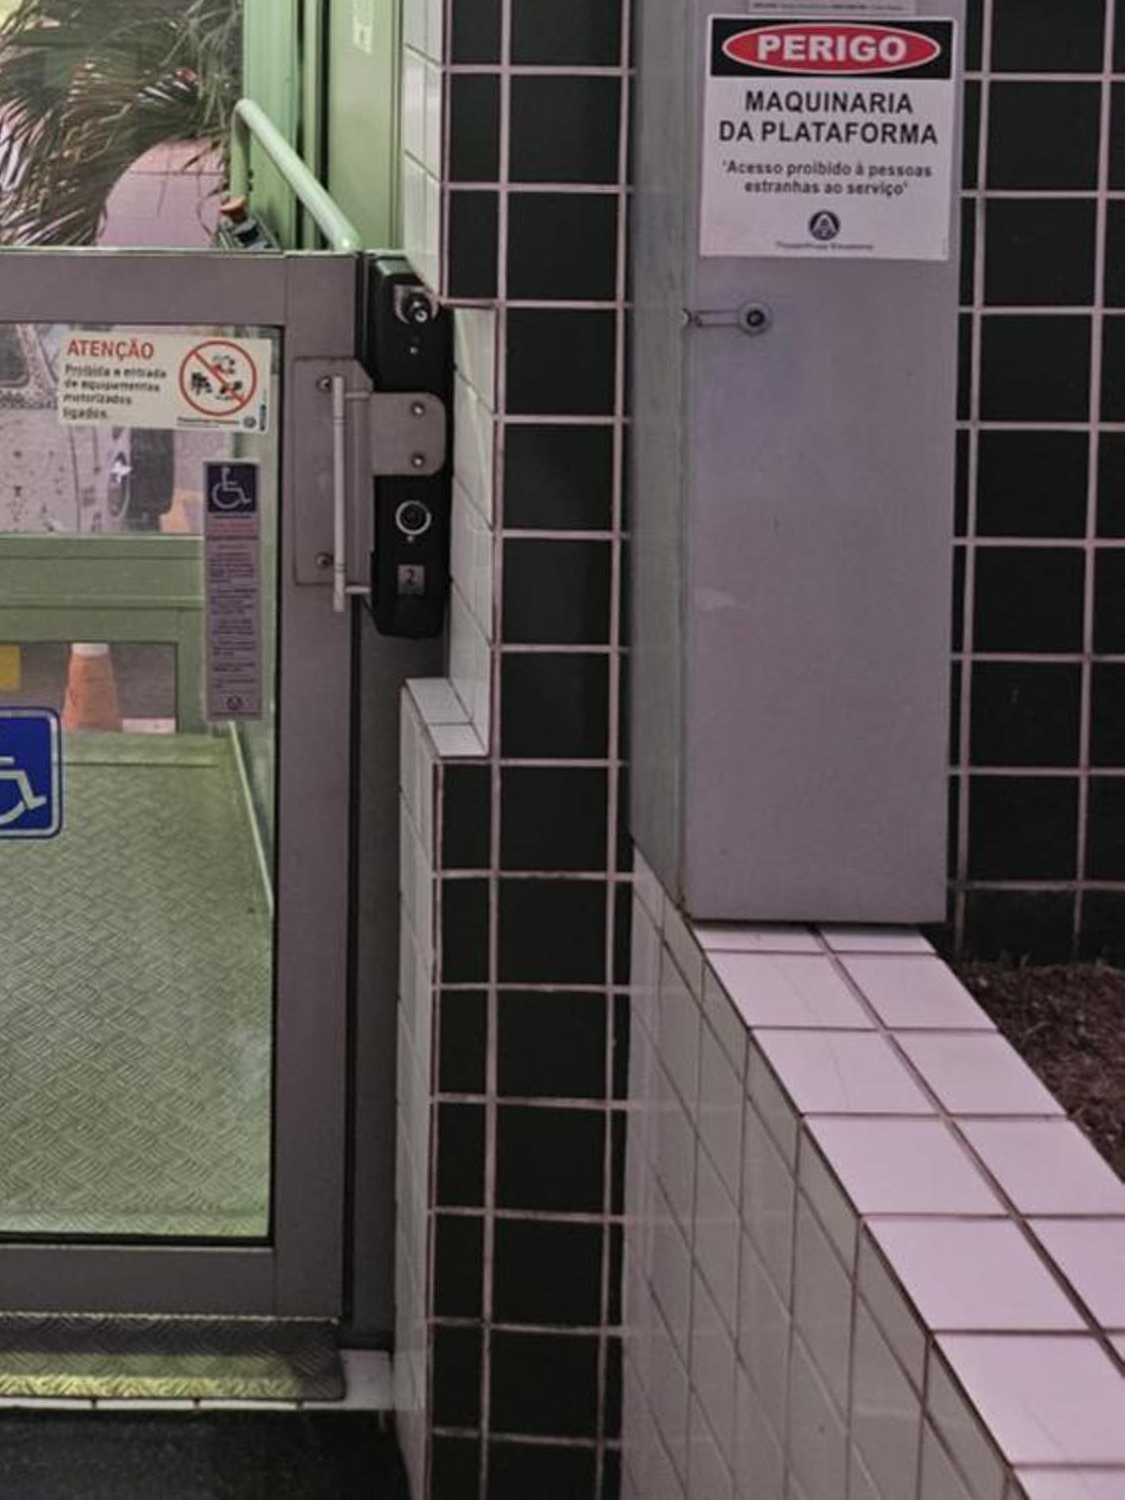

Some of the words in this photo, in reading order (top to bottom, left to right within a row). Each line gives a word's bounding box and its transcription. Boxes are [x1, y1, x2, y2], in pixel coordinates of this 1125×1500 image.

[757, 35, 907, 62] PERIGO
[745, 91, 913, 114] MAQUINARIA
[719, 120, 753, 141] DA
[762, 121, 938, 145] PLATAFORMA
[786, 160, 852, 179] proibido
[868, 164, 933, 181] pessoas
[744, 179, 820, 194] estranhas
[824, 183, 844, 195] ao
[66, 337, 156, 362] ATENÇÃO
[64, 364, 111, 378] Proibida
[123, 367, 167, 379] entrada
[64, 378, 78, 389] de
[63, 392, 132, 406] motorizados
